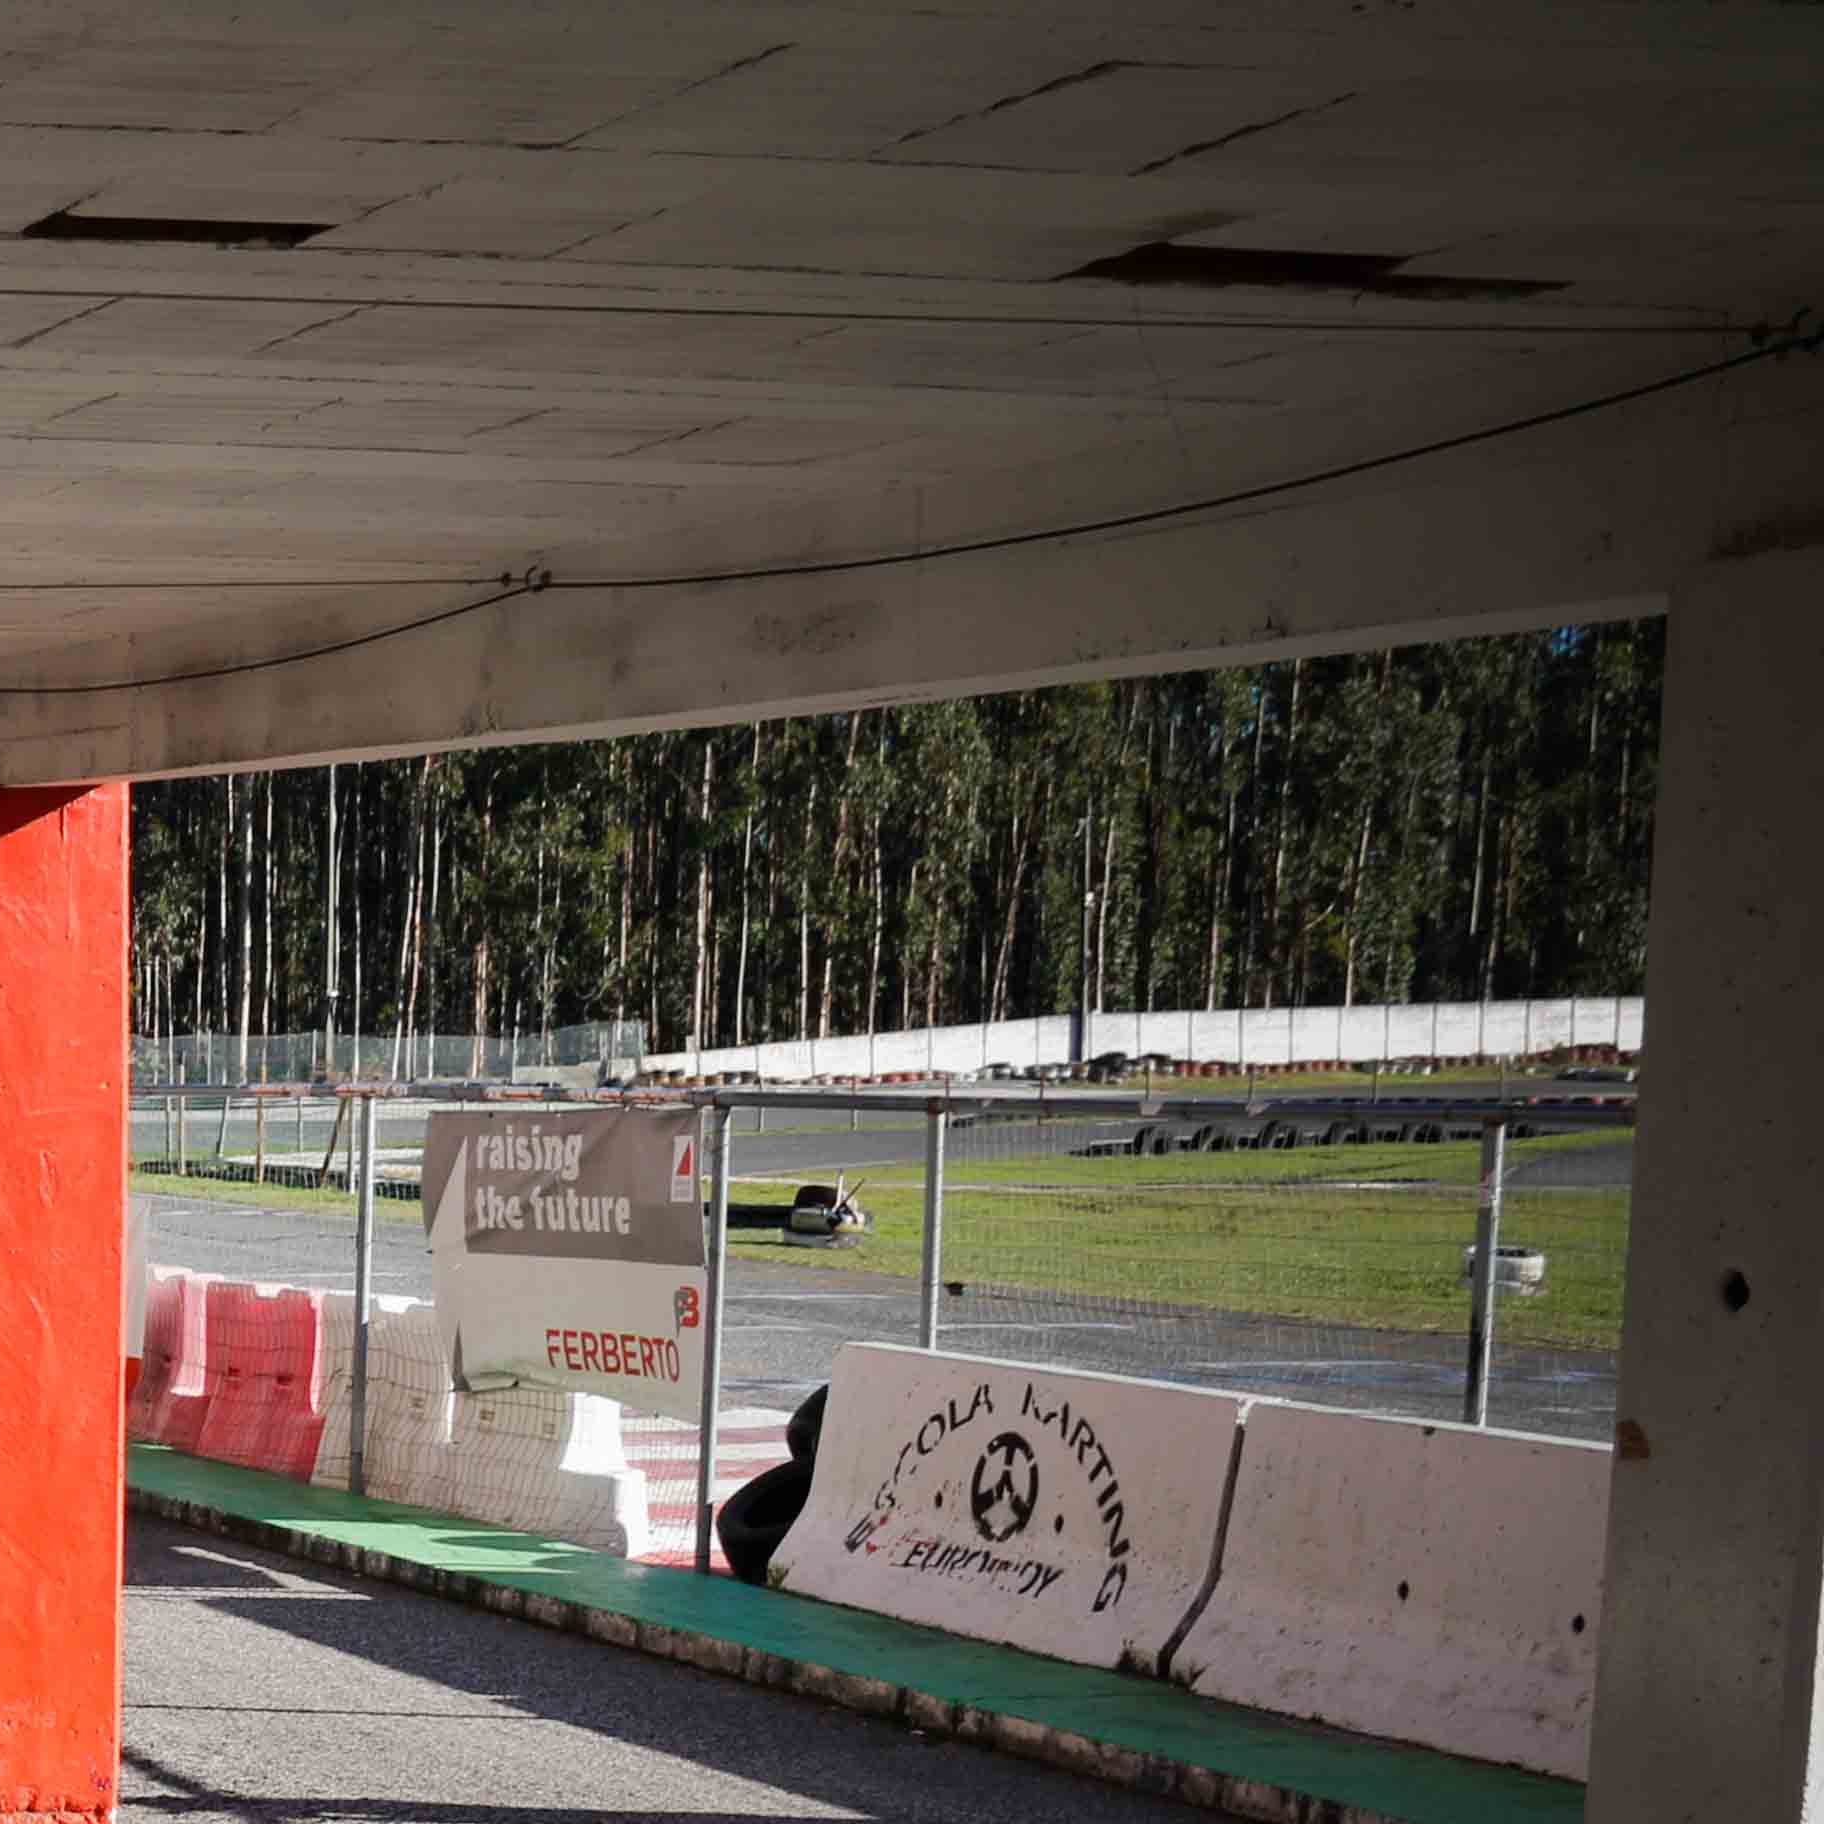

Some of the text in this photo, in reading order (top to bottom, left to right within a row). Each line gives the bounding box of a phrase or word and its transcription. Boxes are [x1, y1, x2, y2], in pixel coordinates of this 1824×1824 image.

[476, 1125, 583, 1181] raising
[475, 1187, 524, 1230] the
[530, 1186, 631, 1234] future
[545, 1329, 681, 1382] FERBERTO
